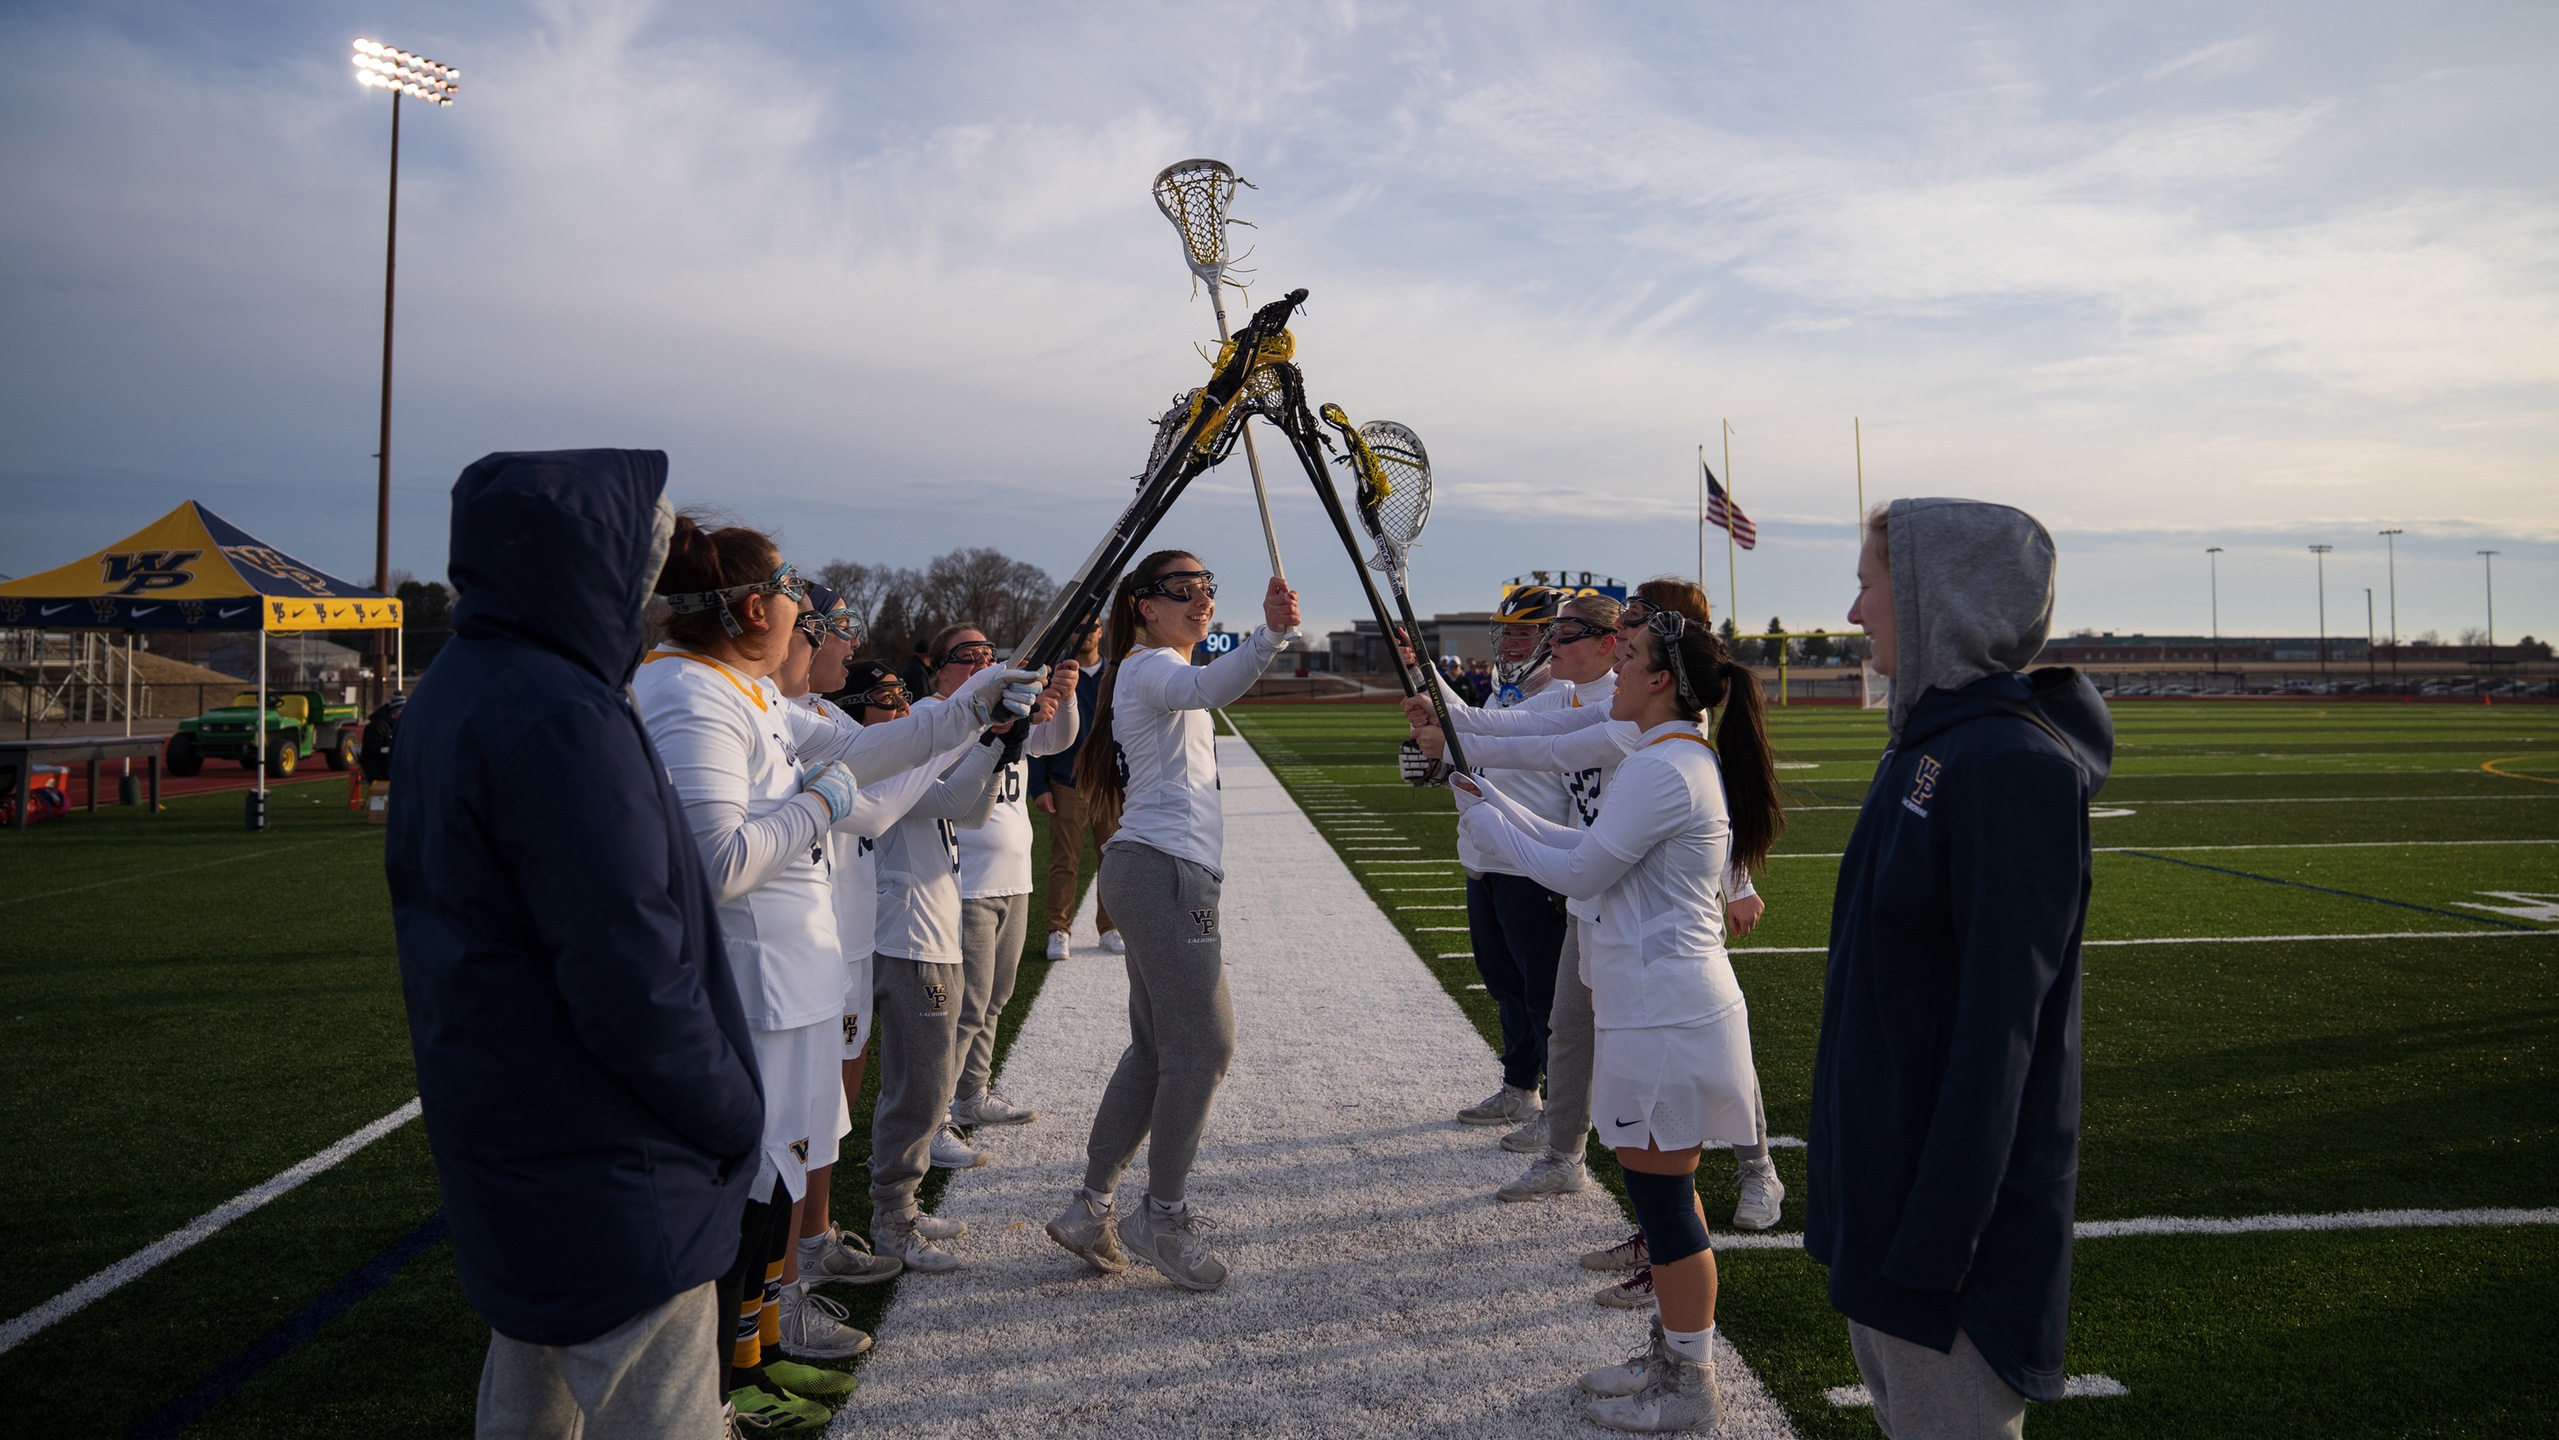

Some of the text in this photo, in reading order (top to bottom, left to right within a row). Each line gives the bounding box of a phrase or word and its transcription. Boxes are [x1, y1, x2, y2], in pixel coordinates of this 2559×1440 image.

[99, 549, 203, 596] WP
[221, 546, 335, 597] WP
[1206, 633, 1231, 653] 90
[842, 695, 863, 706] STX
[1427, 678, 1446, 719] SIGNATURE
[1188, 908, 1216, 937] WP
[923, 984, 949, 1010] WP
